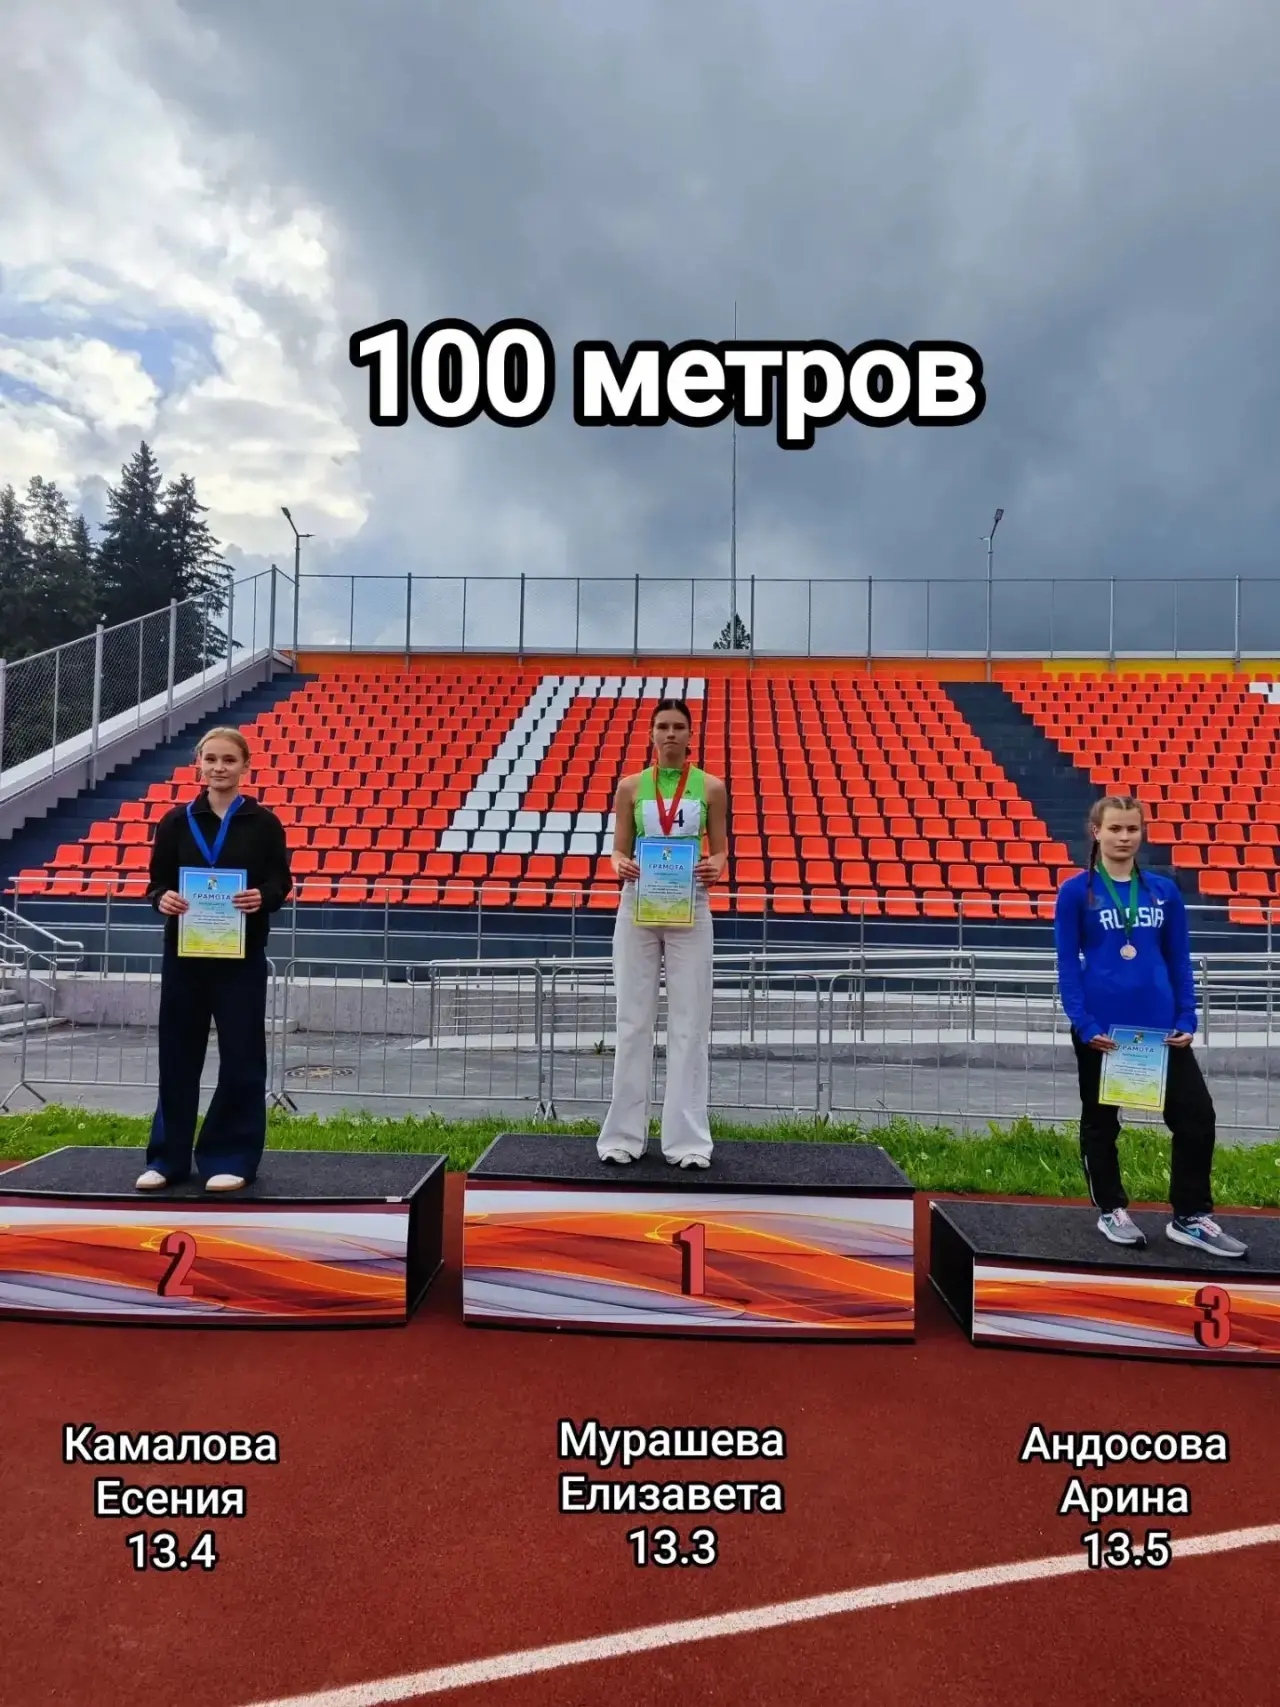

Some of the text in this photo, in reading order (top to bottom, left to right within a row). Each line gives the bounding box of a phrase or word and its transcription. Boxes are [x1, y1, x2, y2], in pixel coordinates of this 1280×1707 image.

[648, 863, 684, 871] ГРАМОТА
[157, 1230, 197, 1297] 2
[672, 1222, 705, 1296] 1
[1194, 1285, 1231, 1349] 3
